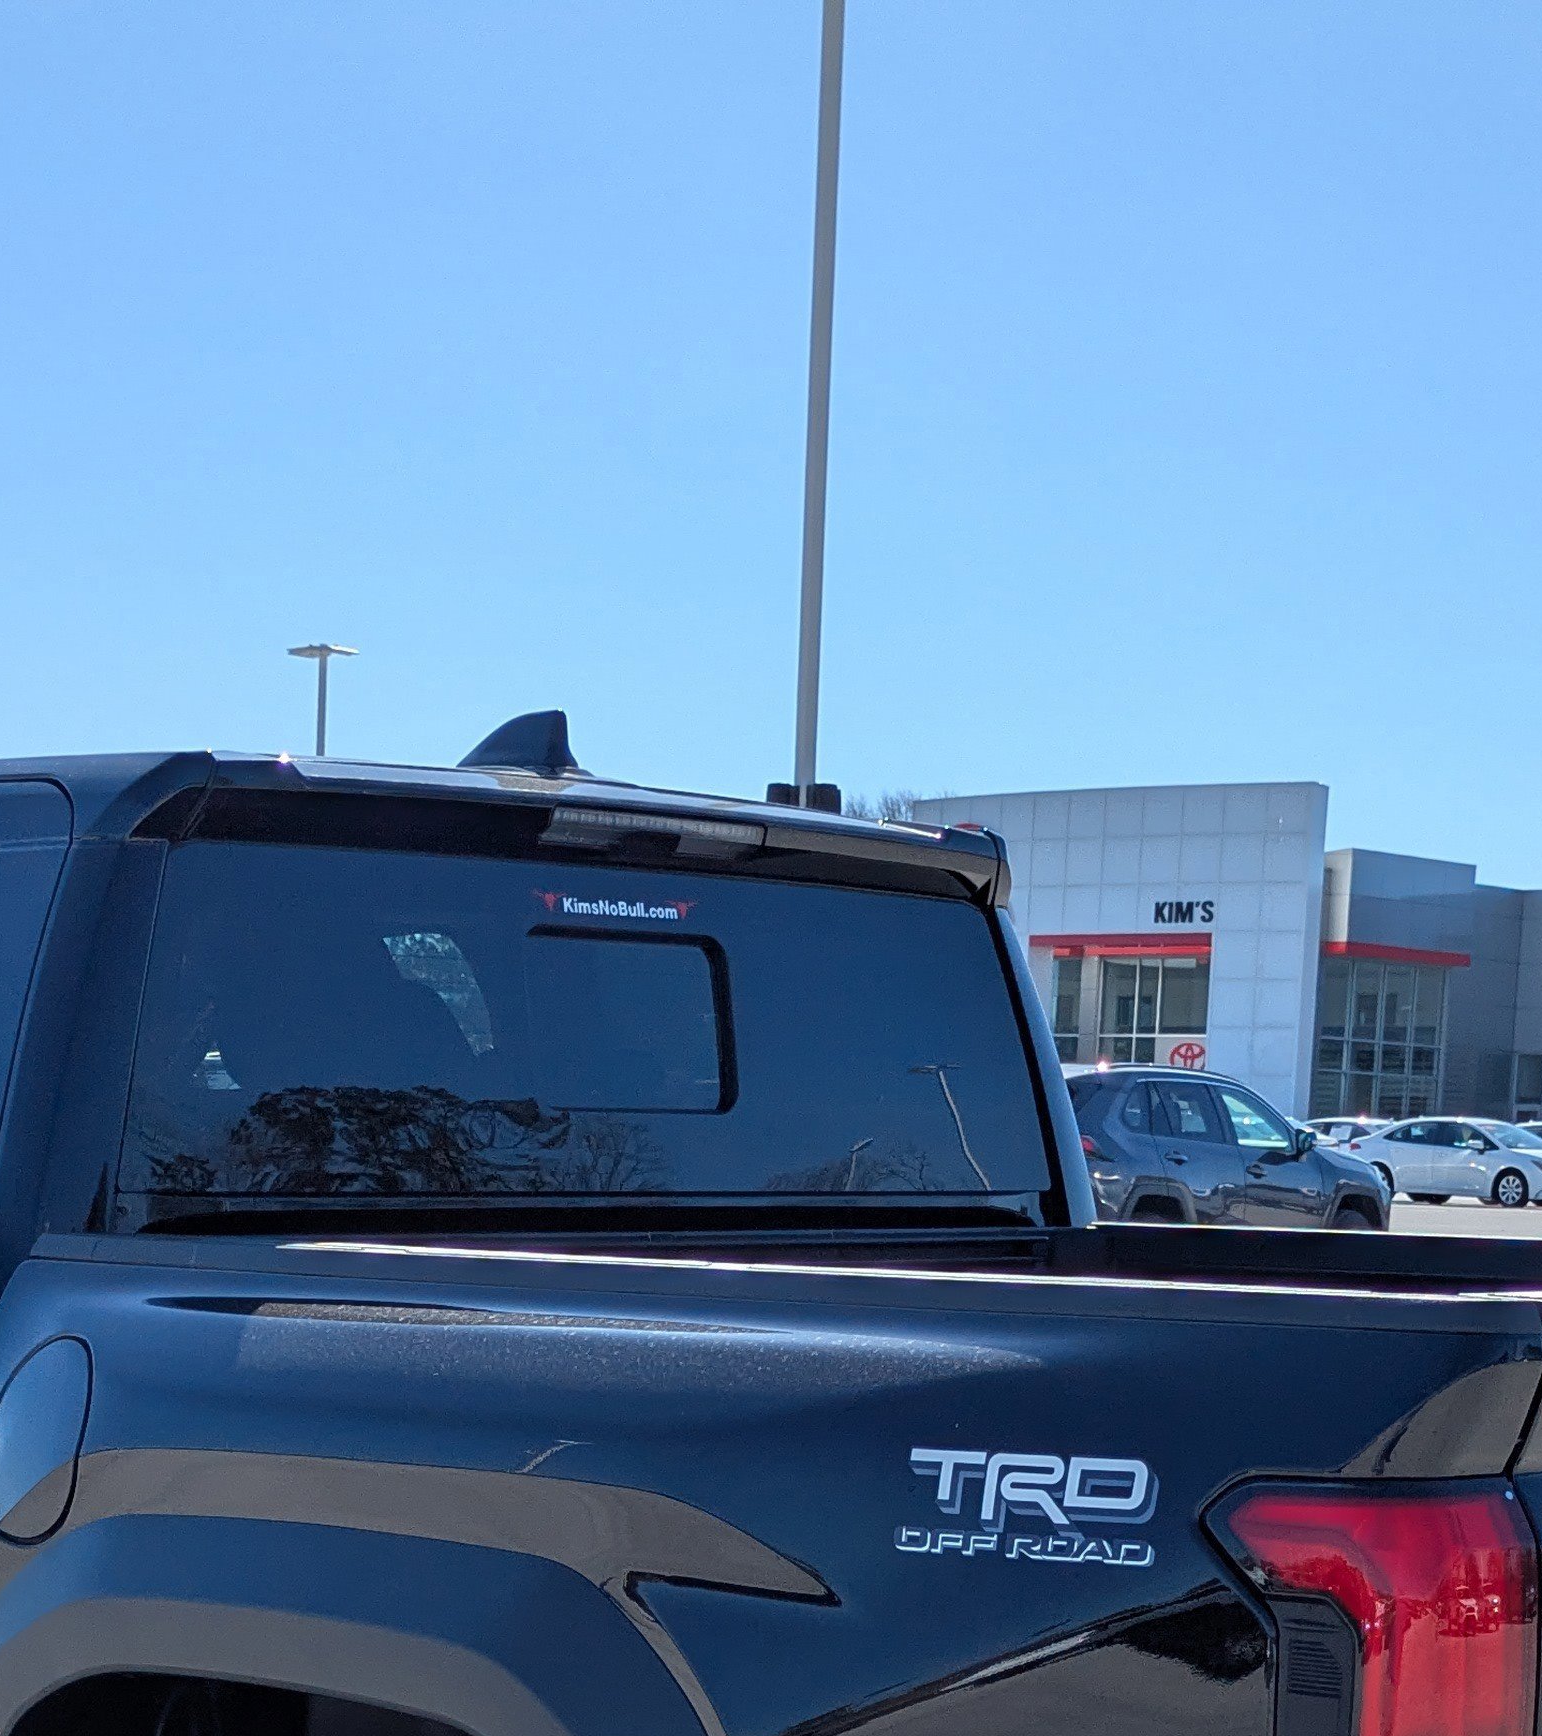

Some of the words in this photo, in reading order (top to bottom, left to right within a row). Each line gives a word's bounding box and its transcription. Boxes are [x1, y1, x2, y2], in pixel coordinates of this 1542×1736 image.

[562, 897, 679, 920] KimsNoBull.com
[1154, 901, 1215, 923] KIM'S
[910, 1448, 1158, 1536] TRD
[894, 1526, 997, 1557] OFF
[1006, 1532, 1155, 1567] ROAD
